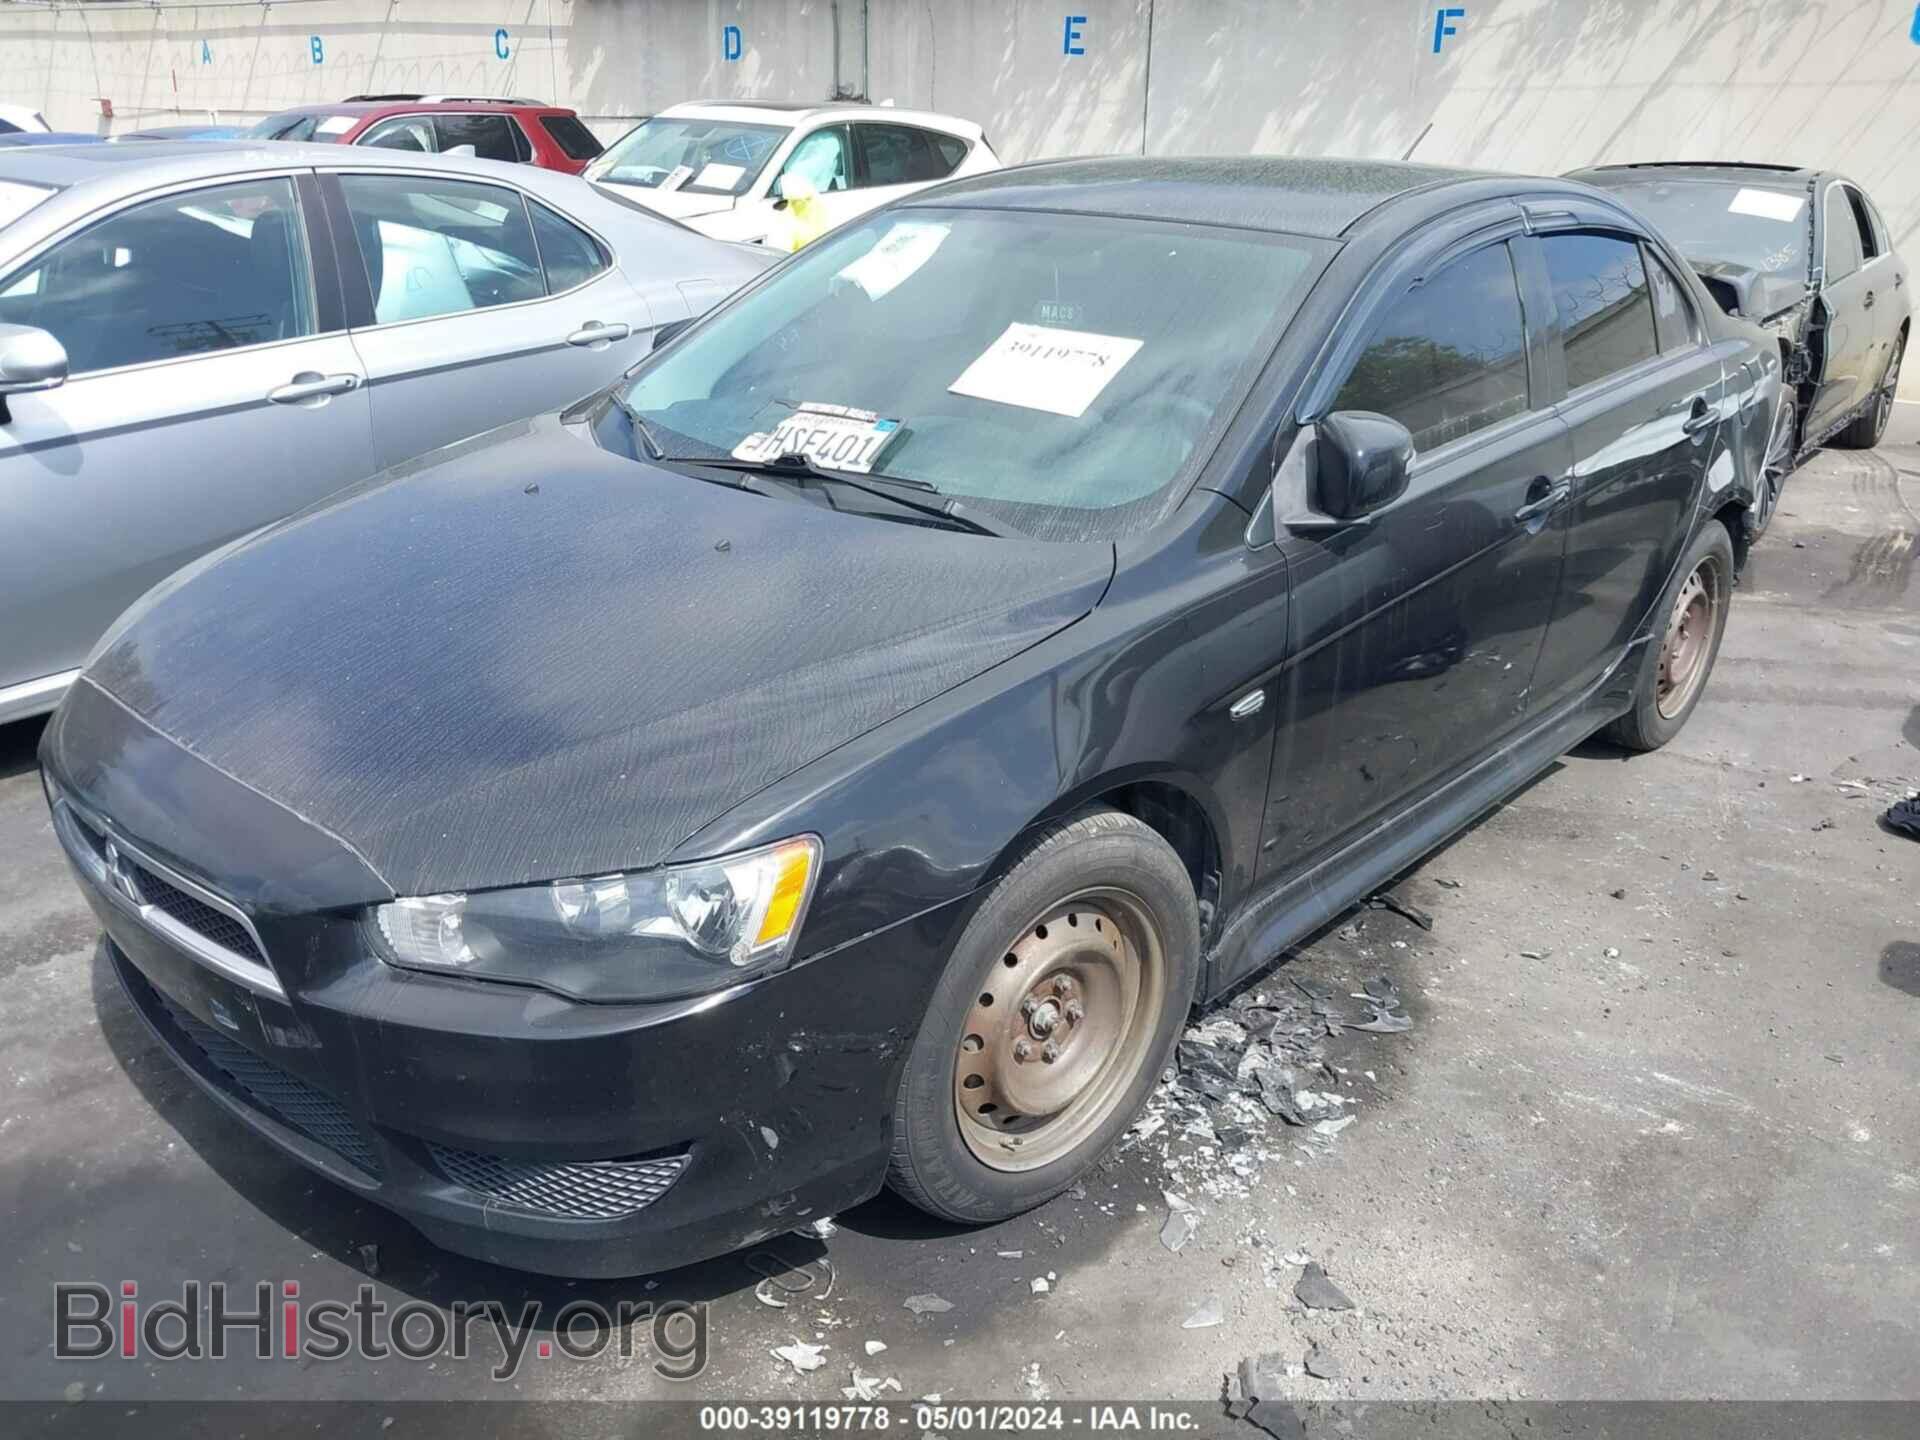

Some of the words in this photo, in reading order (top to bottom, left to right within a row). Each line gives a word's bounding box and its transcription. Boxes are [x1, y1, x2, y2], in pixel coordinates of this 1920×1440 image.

[494, 27, 510, 60] C
[723, 24, 744, 62] D
[1062, 15, 1089, 57] E
[1432, 8, 1466, 54] F
[201, 41, 212, 65] A
[310, 36, 324, 65] B
